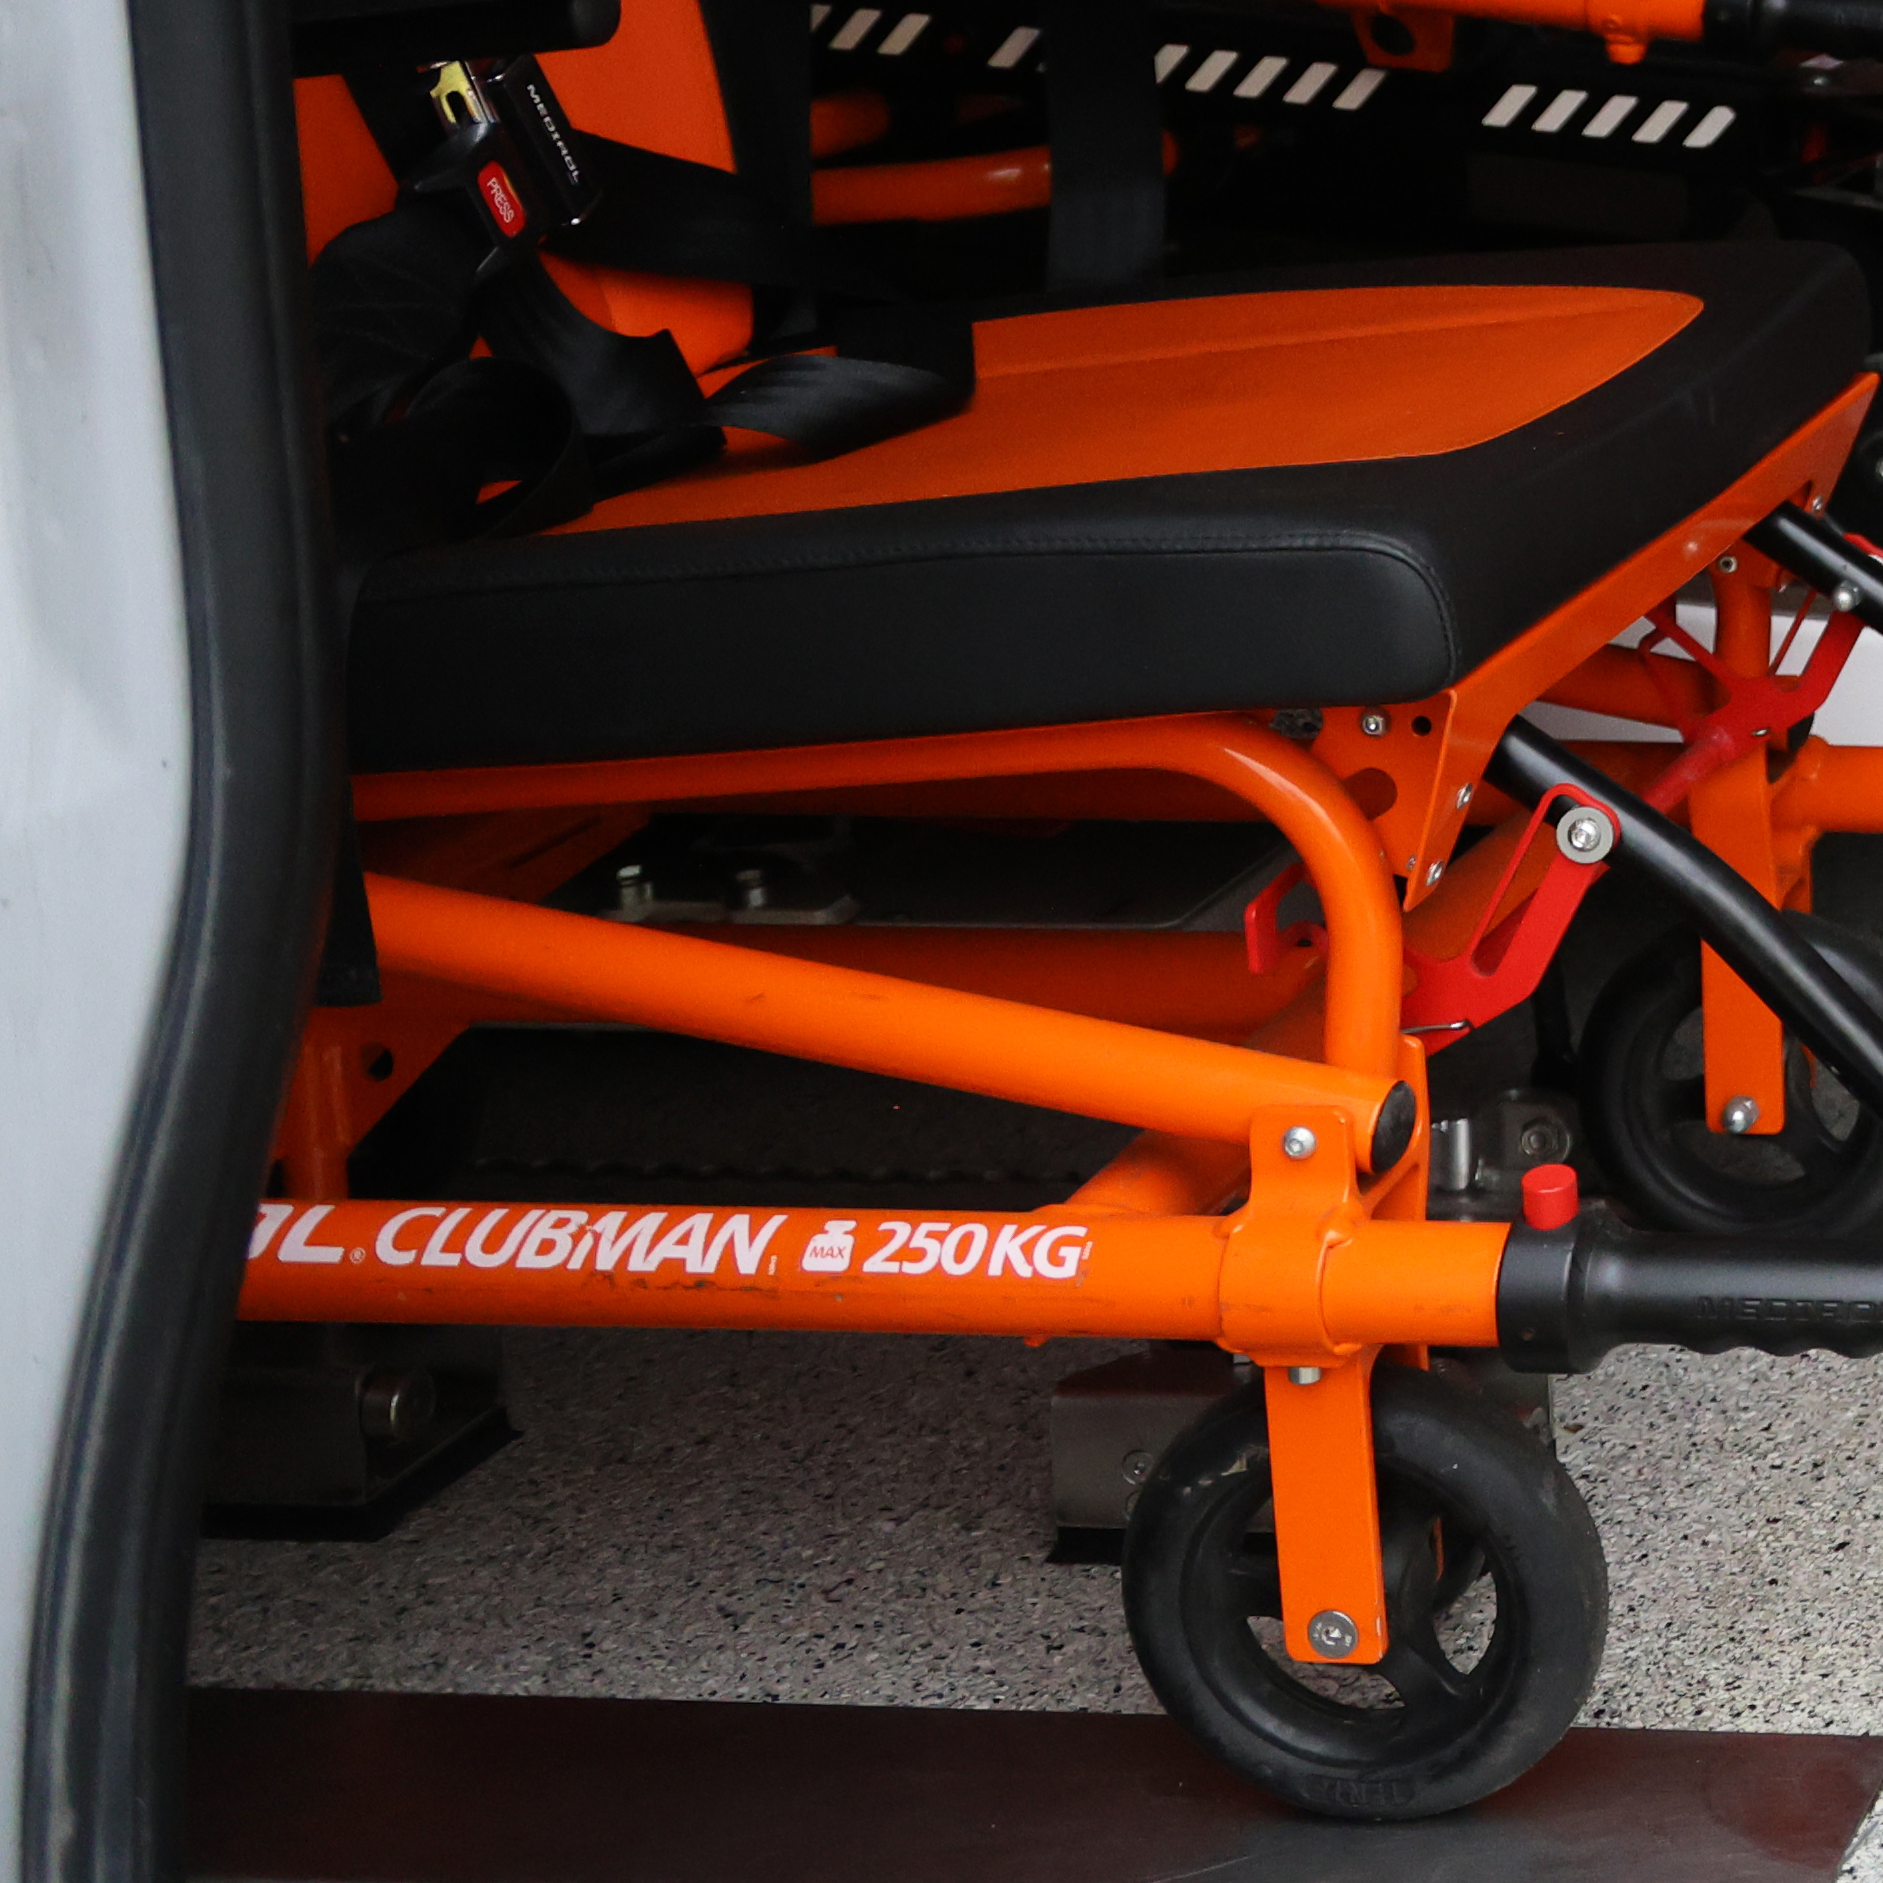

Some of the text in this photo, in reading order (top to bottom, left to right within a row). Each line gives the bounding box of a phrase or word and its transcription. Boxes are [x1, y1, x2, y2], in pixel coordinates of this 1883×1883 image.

[526, 83, 581, 184] MEDIROL
[486, 176, 516, 224] PRESS
[374, 1206, 788, 1276] CLUBMAN
[808, 1245, 848, 1261] MAX
[862, 1221, 1089, 1279] 250KG
